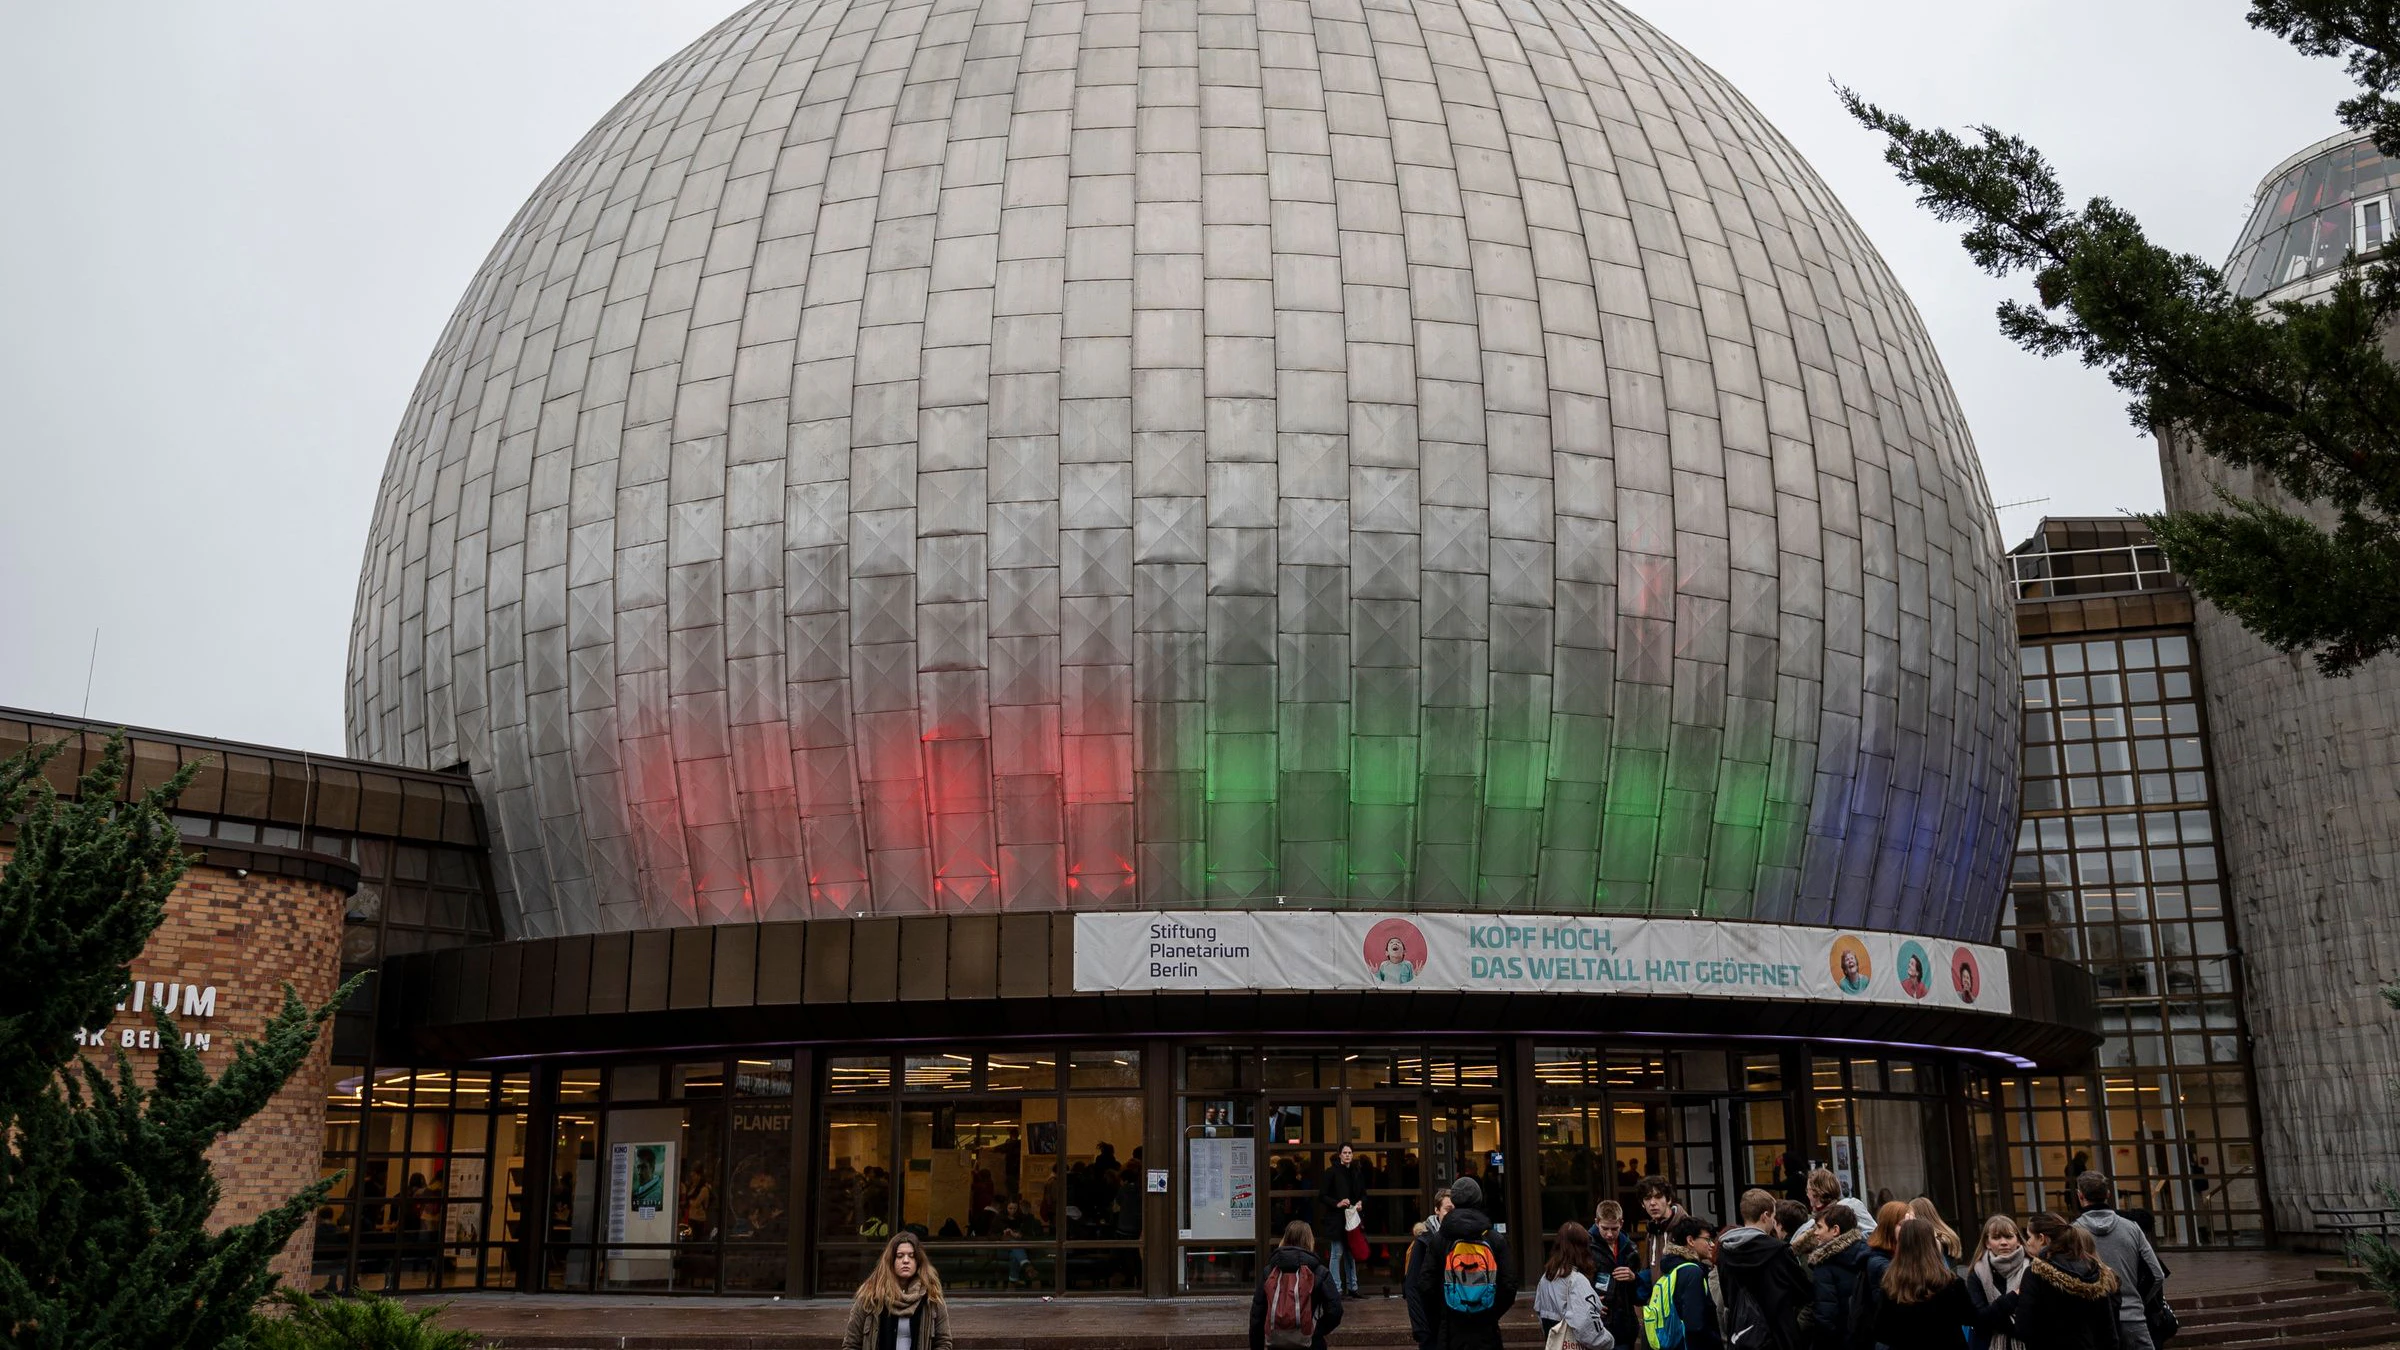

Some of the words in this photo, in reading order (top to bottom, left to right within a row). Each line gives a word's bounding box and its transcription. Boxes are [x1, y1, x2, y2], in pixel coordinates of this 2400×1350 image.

[1150, 924, 1216, 942] Stiftung
[1470, 925, 1536, 949] KOPF
[1543, 927, 1617, 955] HOCH,
[1150, 943, 1250, 958] Planetarium
[1150, 962, 1198, 977] Berlin
[1472, 956, 1523, 979] DAS
[1528, 957, 1640, 981] WELTALL
[1646, 959, 1690, 982] HAT
[1695, 957, 1801, 986] GEÖFFNET
[114, 981, 217, 1017] IUM
[121, 1028, 211, 1052] BEIN
[733, 1114, 792, 1131] PLANET
